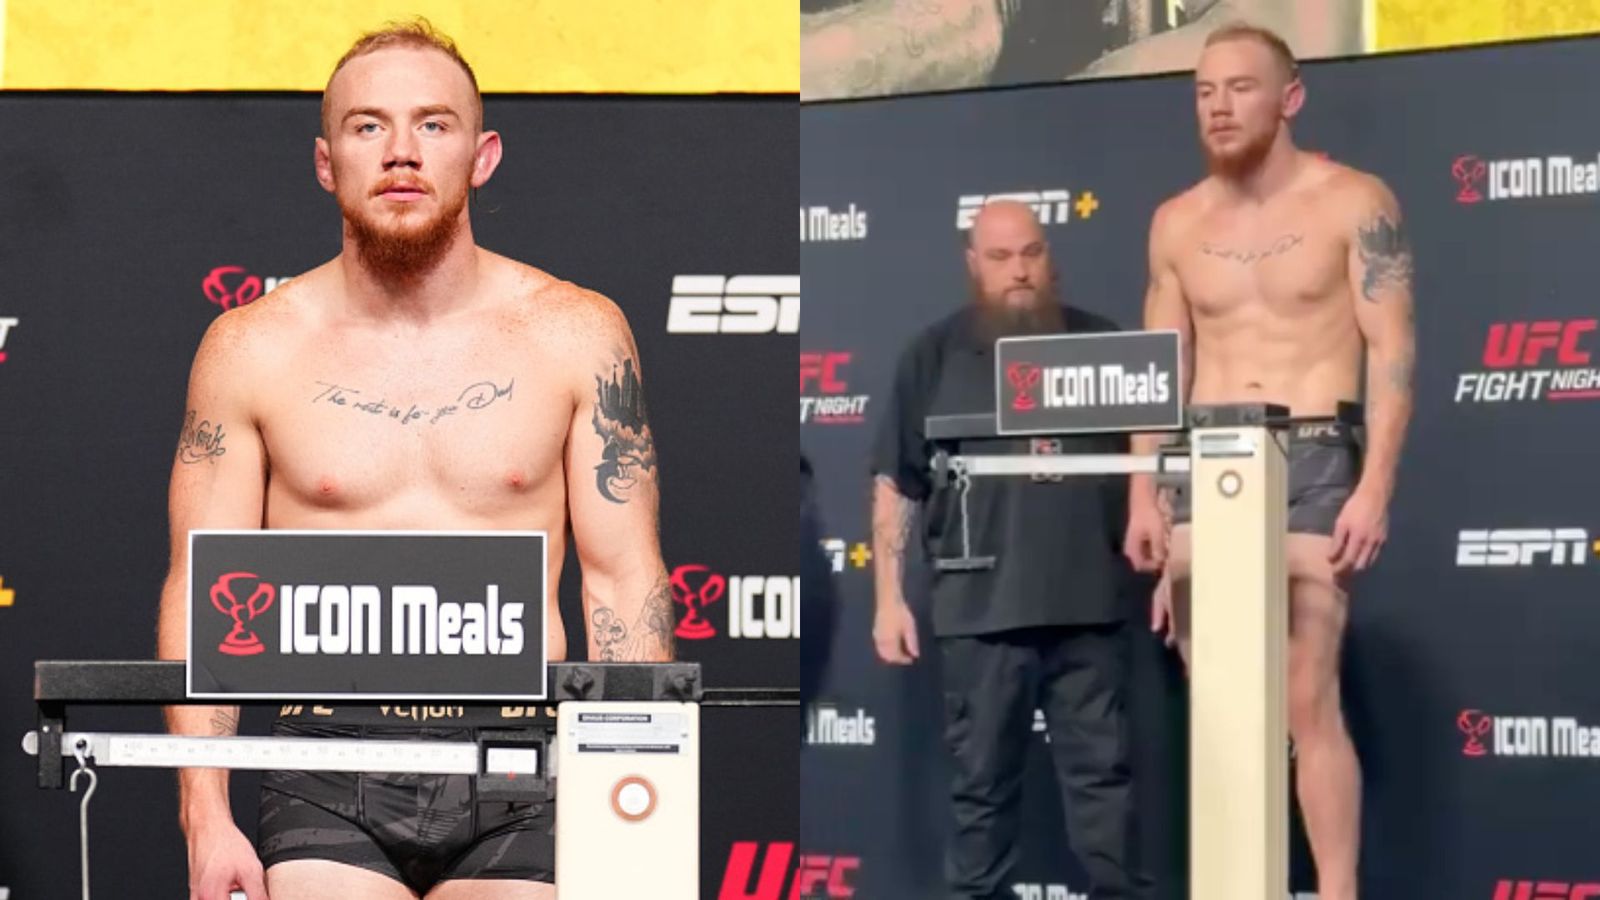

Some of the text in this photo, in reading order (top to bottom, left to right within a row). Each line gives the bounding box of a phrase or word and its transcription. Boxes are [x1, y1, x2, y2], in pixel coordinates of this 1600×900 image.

[1488, 158, 1542, 200] ICON
[809, 203, 867, 242] Meals
[1482, 319, 1597, 368] UFC
[813, 395, 870, 415] NIGHT
[1043, 361, 1170, 408] ICON Meals
[1454, 370, 1551, 402] FIGHT
[279, 584, 525, 655] ICON Meals
[818, 707, 875, 745] Meals
[1493, 716, 1548, 756] ICON
[800, 854, 861, 897] FC
